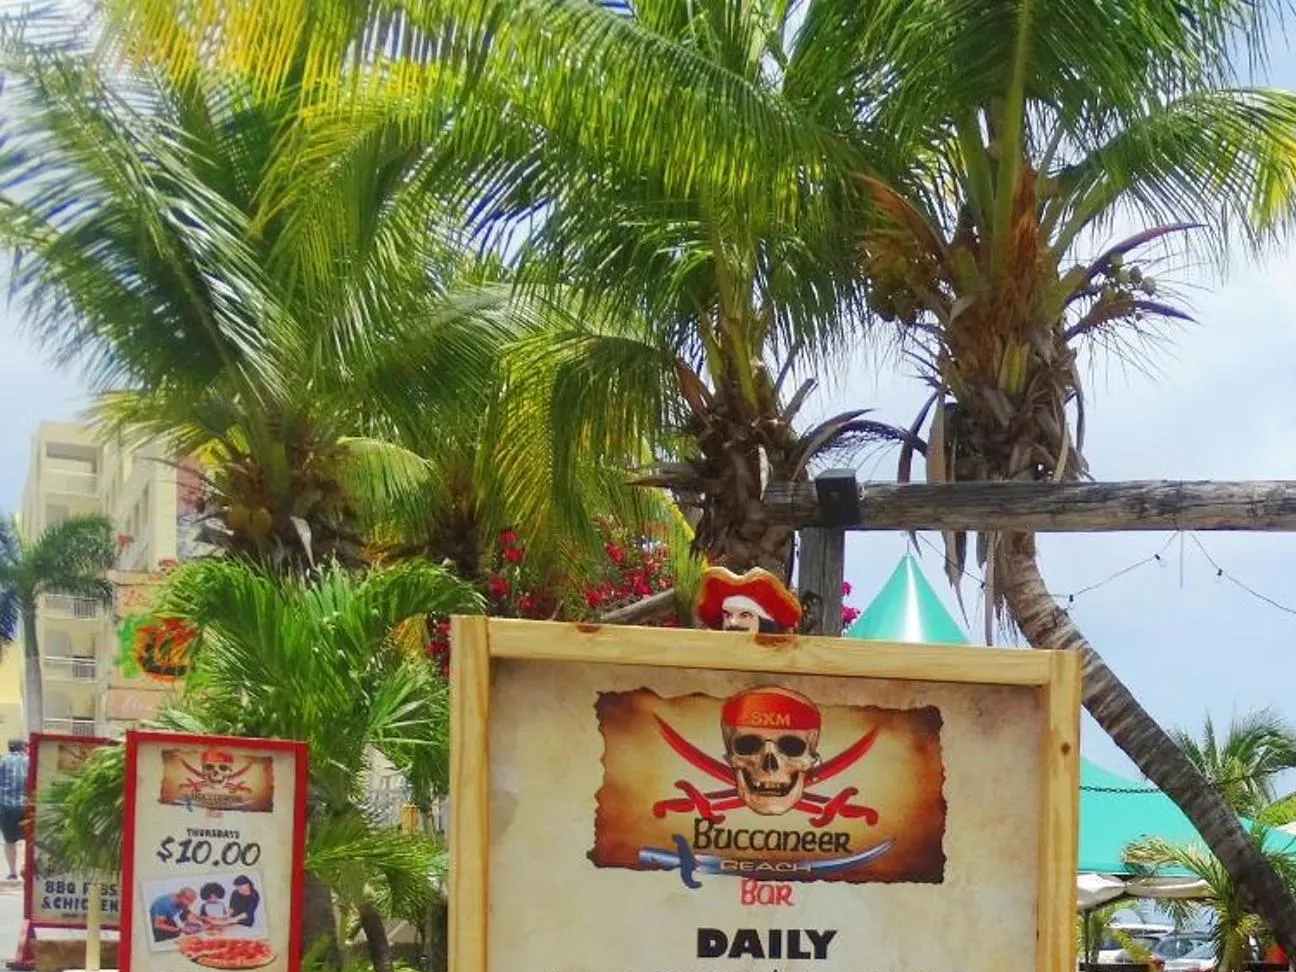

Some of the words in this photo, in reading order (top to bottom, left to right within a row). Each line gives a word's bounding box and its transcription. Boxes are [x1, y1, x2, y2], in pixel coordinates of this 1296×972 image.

[751, 711, 791, 727] SXM
[186, 828, 240, 839] THURSDAYS
[693, 817, 853, 854] Buccaneer
[156, 836, 261, 867] $10.00
[719, 860, 812, 873] BEACH
[45, 880, 76, 894] BBQ
[696, 928, 838, 961] DAILY
